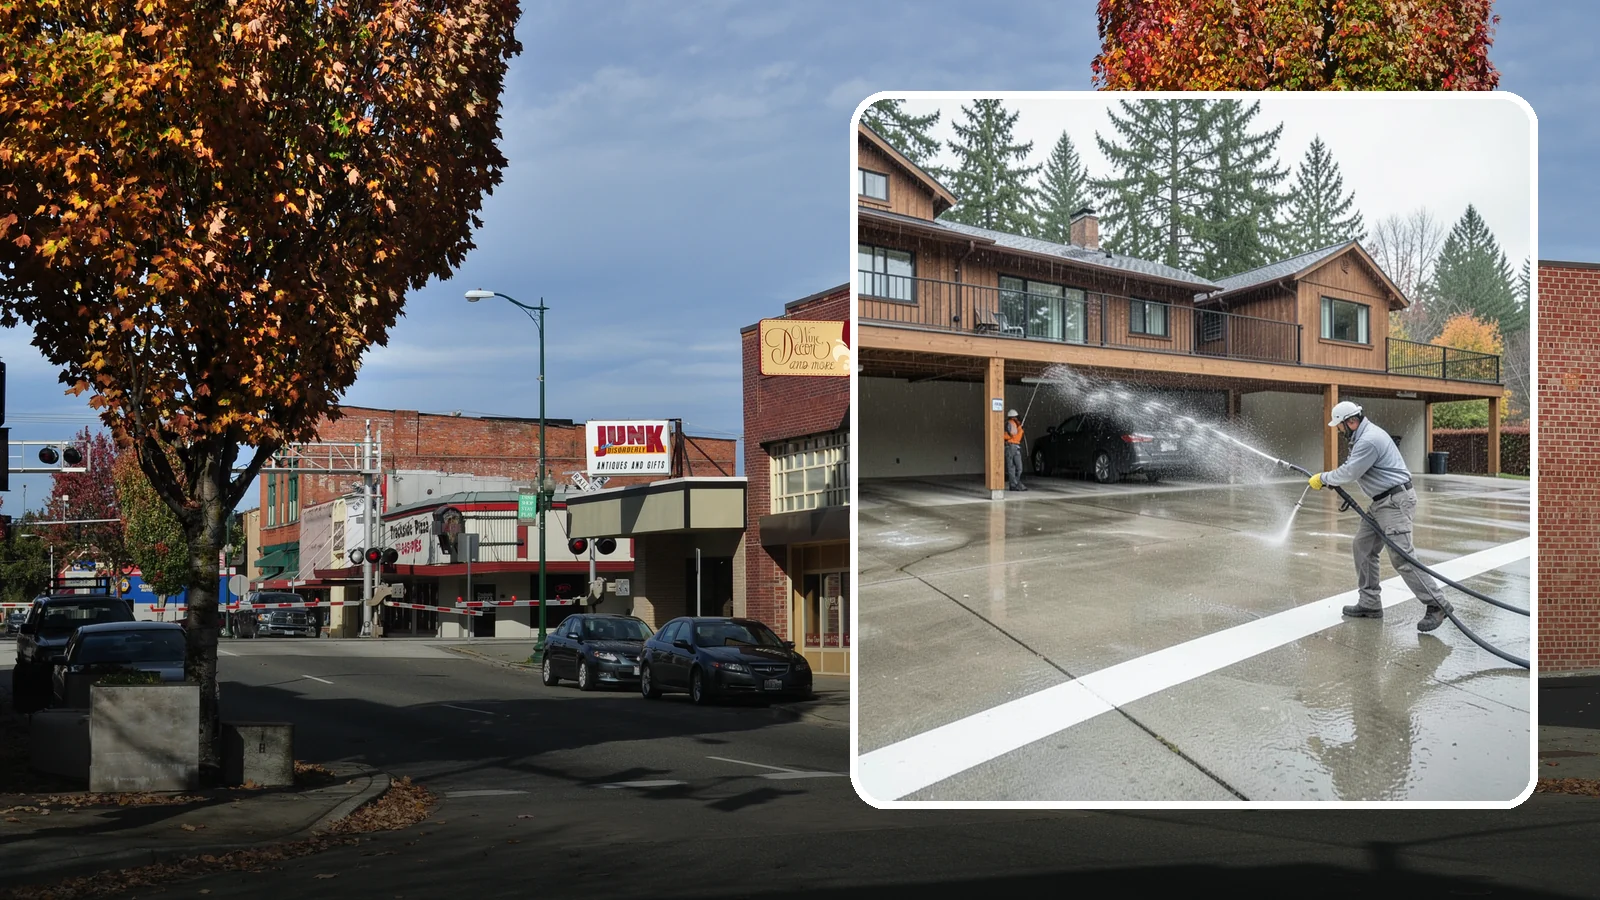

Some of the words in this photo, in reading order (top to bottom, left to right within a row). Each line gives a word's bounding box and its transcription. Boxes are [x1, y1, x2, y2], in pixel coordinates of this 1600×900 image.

[791, 324, 824, 345] Wine
[764, 327, 831, 365] Decor
[595, 425, 665, 457] JUNK
[596, 461, 628, 470] ANTIQUES
[631, 461, 644, 470] AND
[646, 460, 665, 470] GIFTS
[352, 498, 365, 511] CRO
[390, 521, 413, 540] Trackside
[414, 519, 429, 535] Pizza
